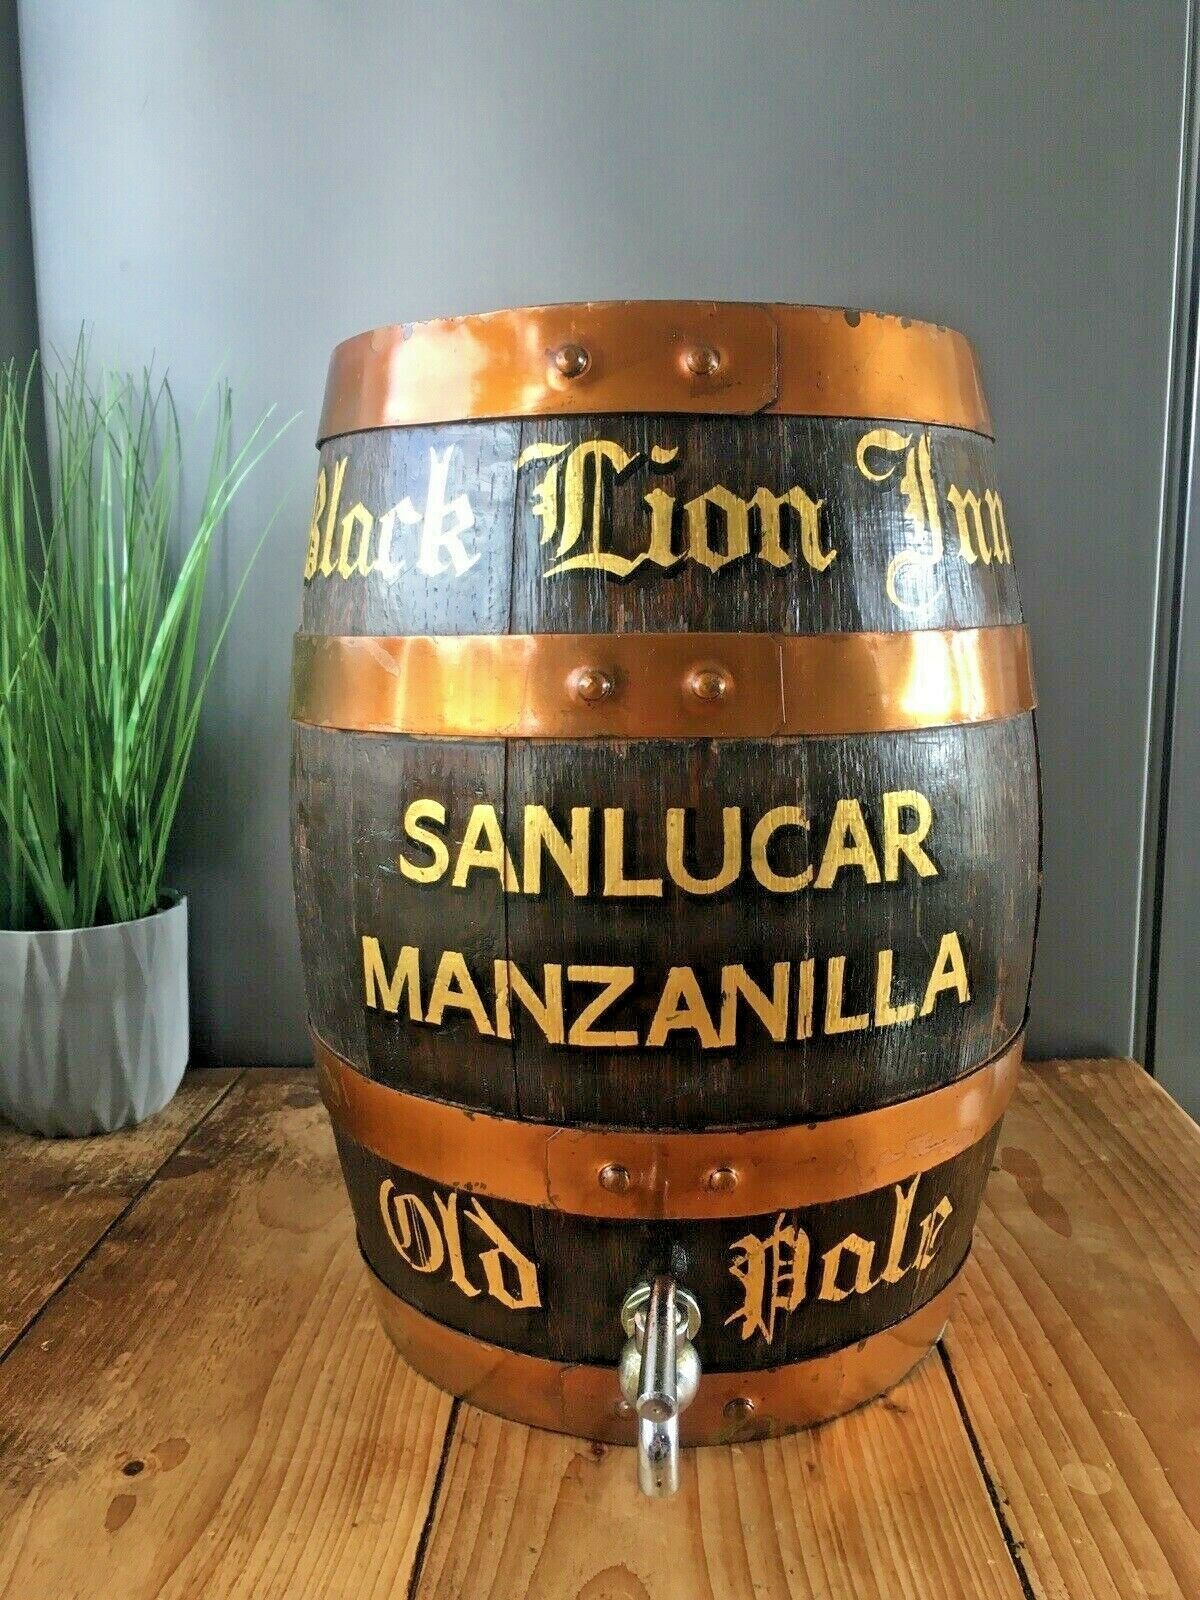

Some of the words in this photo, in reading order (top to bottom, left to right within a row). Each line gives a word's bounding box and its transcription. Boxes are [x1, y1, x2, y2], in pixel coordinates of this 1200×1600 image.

[303, 443, 482, 581] Black
[514, 439, 838, 579] Lion
[855, 426, 1012, 614] Inn
[399, 789, 939, 899] SANLUCAR
[361, 931, 972, 1049] MANZANILLA
[379, 1178, 542, 1310] Old
[723, 1172, 954, 1346] Pale
